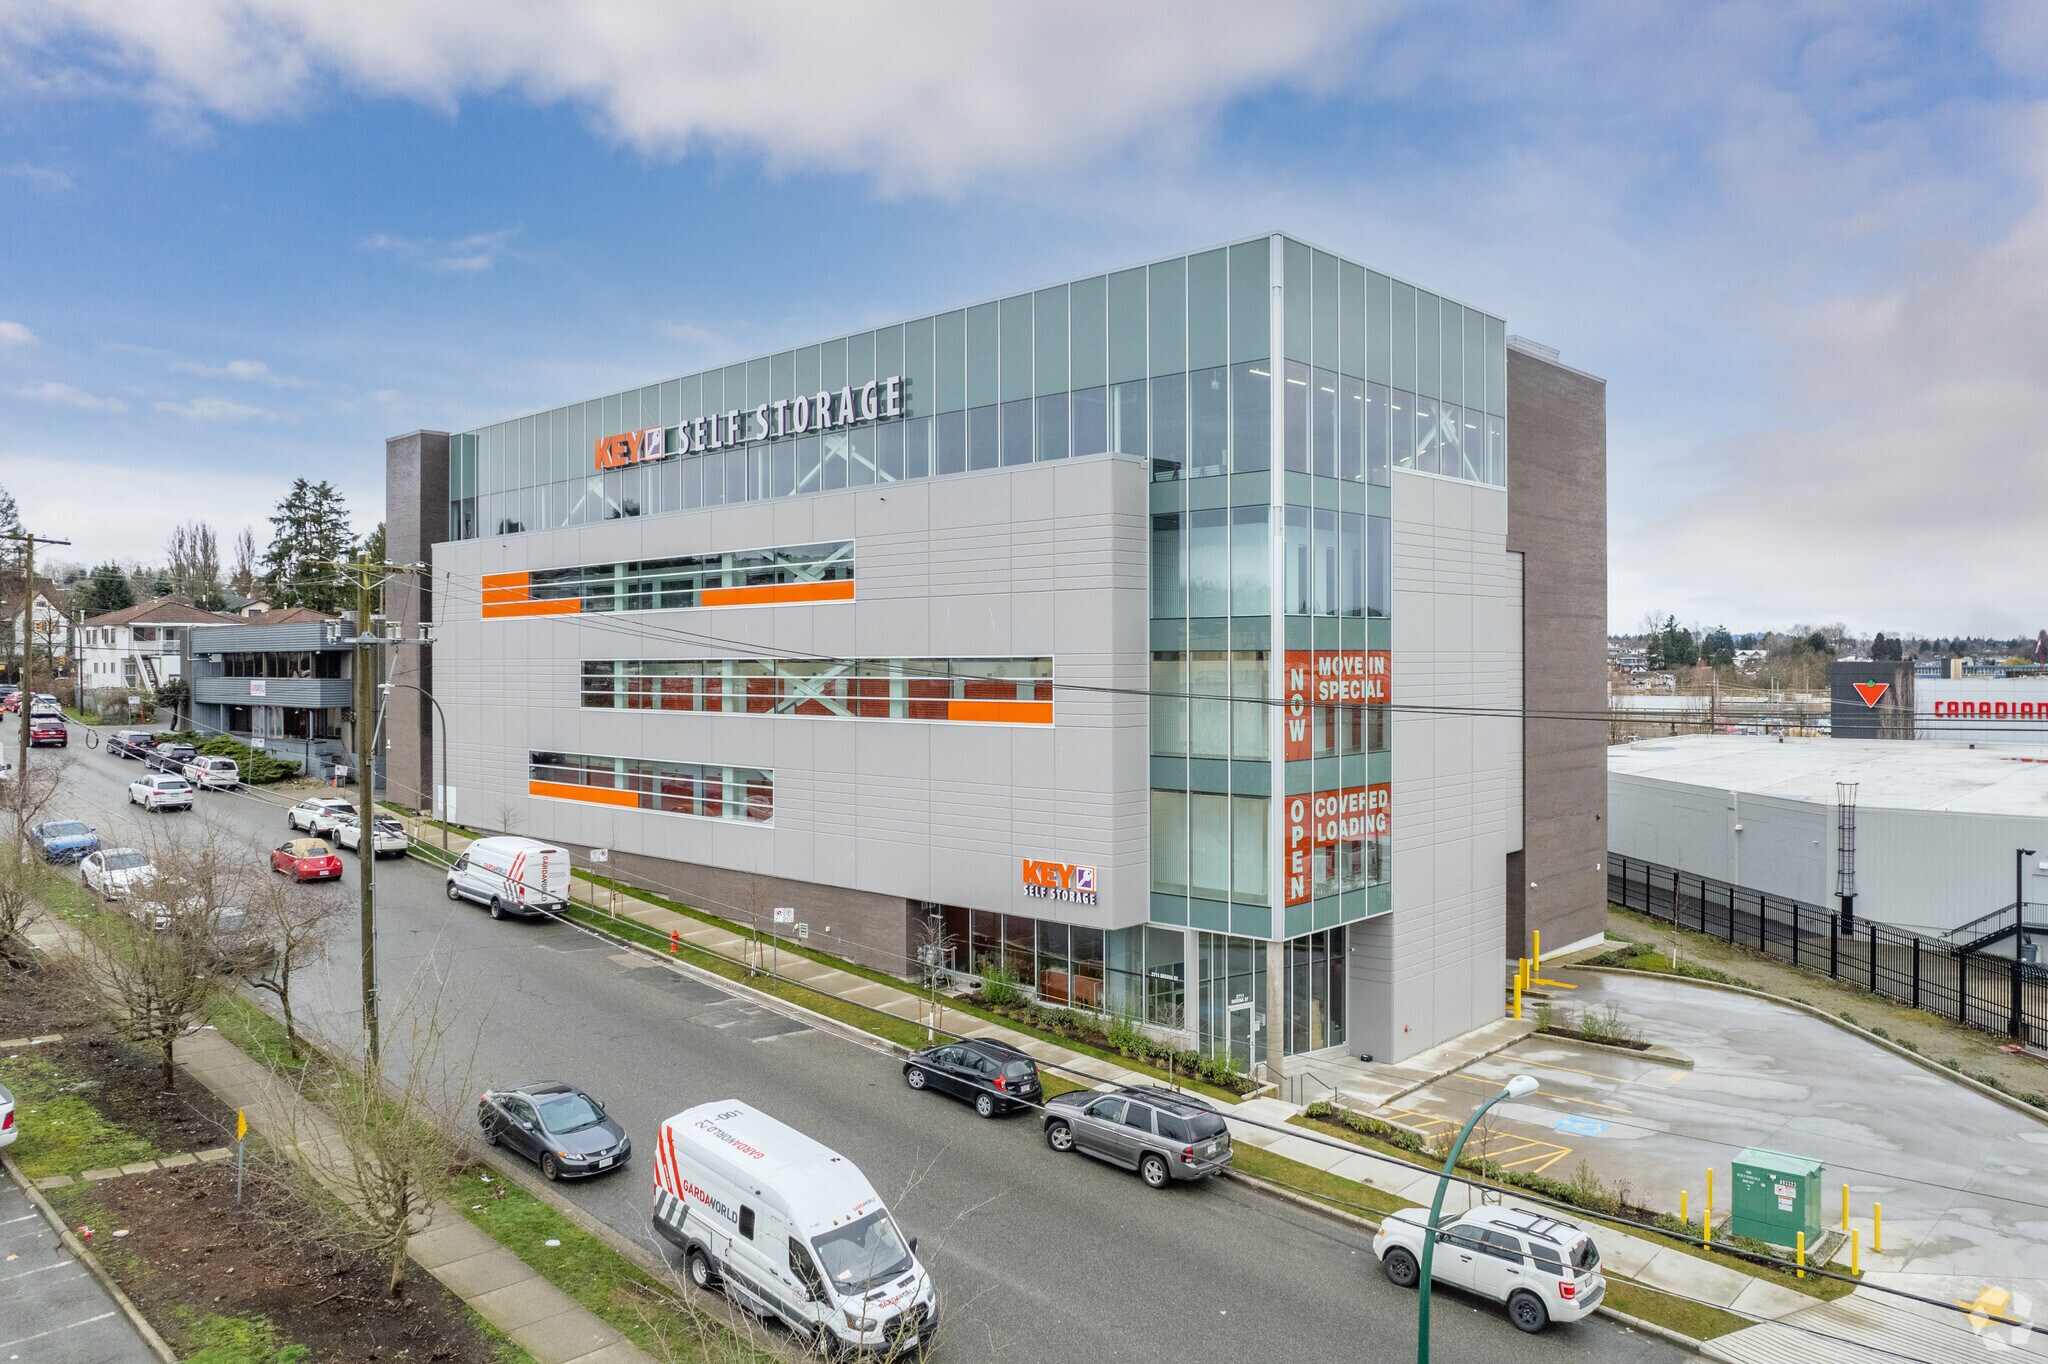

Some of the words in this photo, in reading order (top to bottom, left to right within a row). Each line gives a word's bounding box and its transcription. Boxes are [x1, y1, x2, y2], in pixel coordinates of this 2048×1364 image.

[595, 430, 645, 470] KEY
[678, 410, 741, 455] SELF
[755, 375, 904, 440] STORAGE
[1318, 656, 1363, 676] MOVE
[1368, 656, 1385, 675] IN
[1289, 668, 1306, 742] NOW
[1319, 679, 1385, 701] SPECIAL
[1934, 701, 2048, 719] CANADIAN
[1317, 812, 1386, 842] LOADING
[1290, 799, 1305, 900] OPEN
[1022, 858, 1075, 889] KEY
[1023, 885, 1046, 898] SELF
[1050, 889, 1096, 905] STORAGE
[706, 1126, 765, 1160] GARDAWORLD
[683, 1179, 738, 1224] GARDAWORLD
